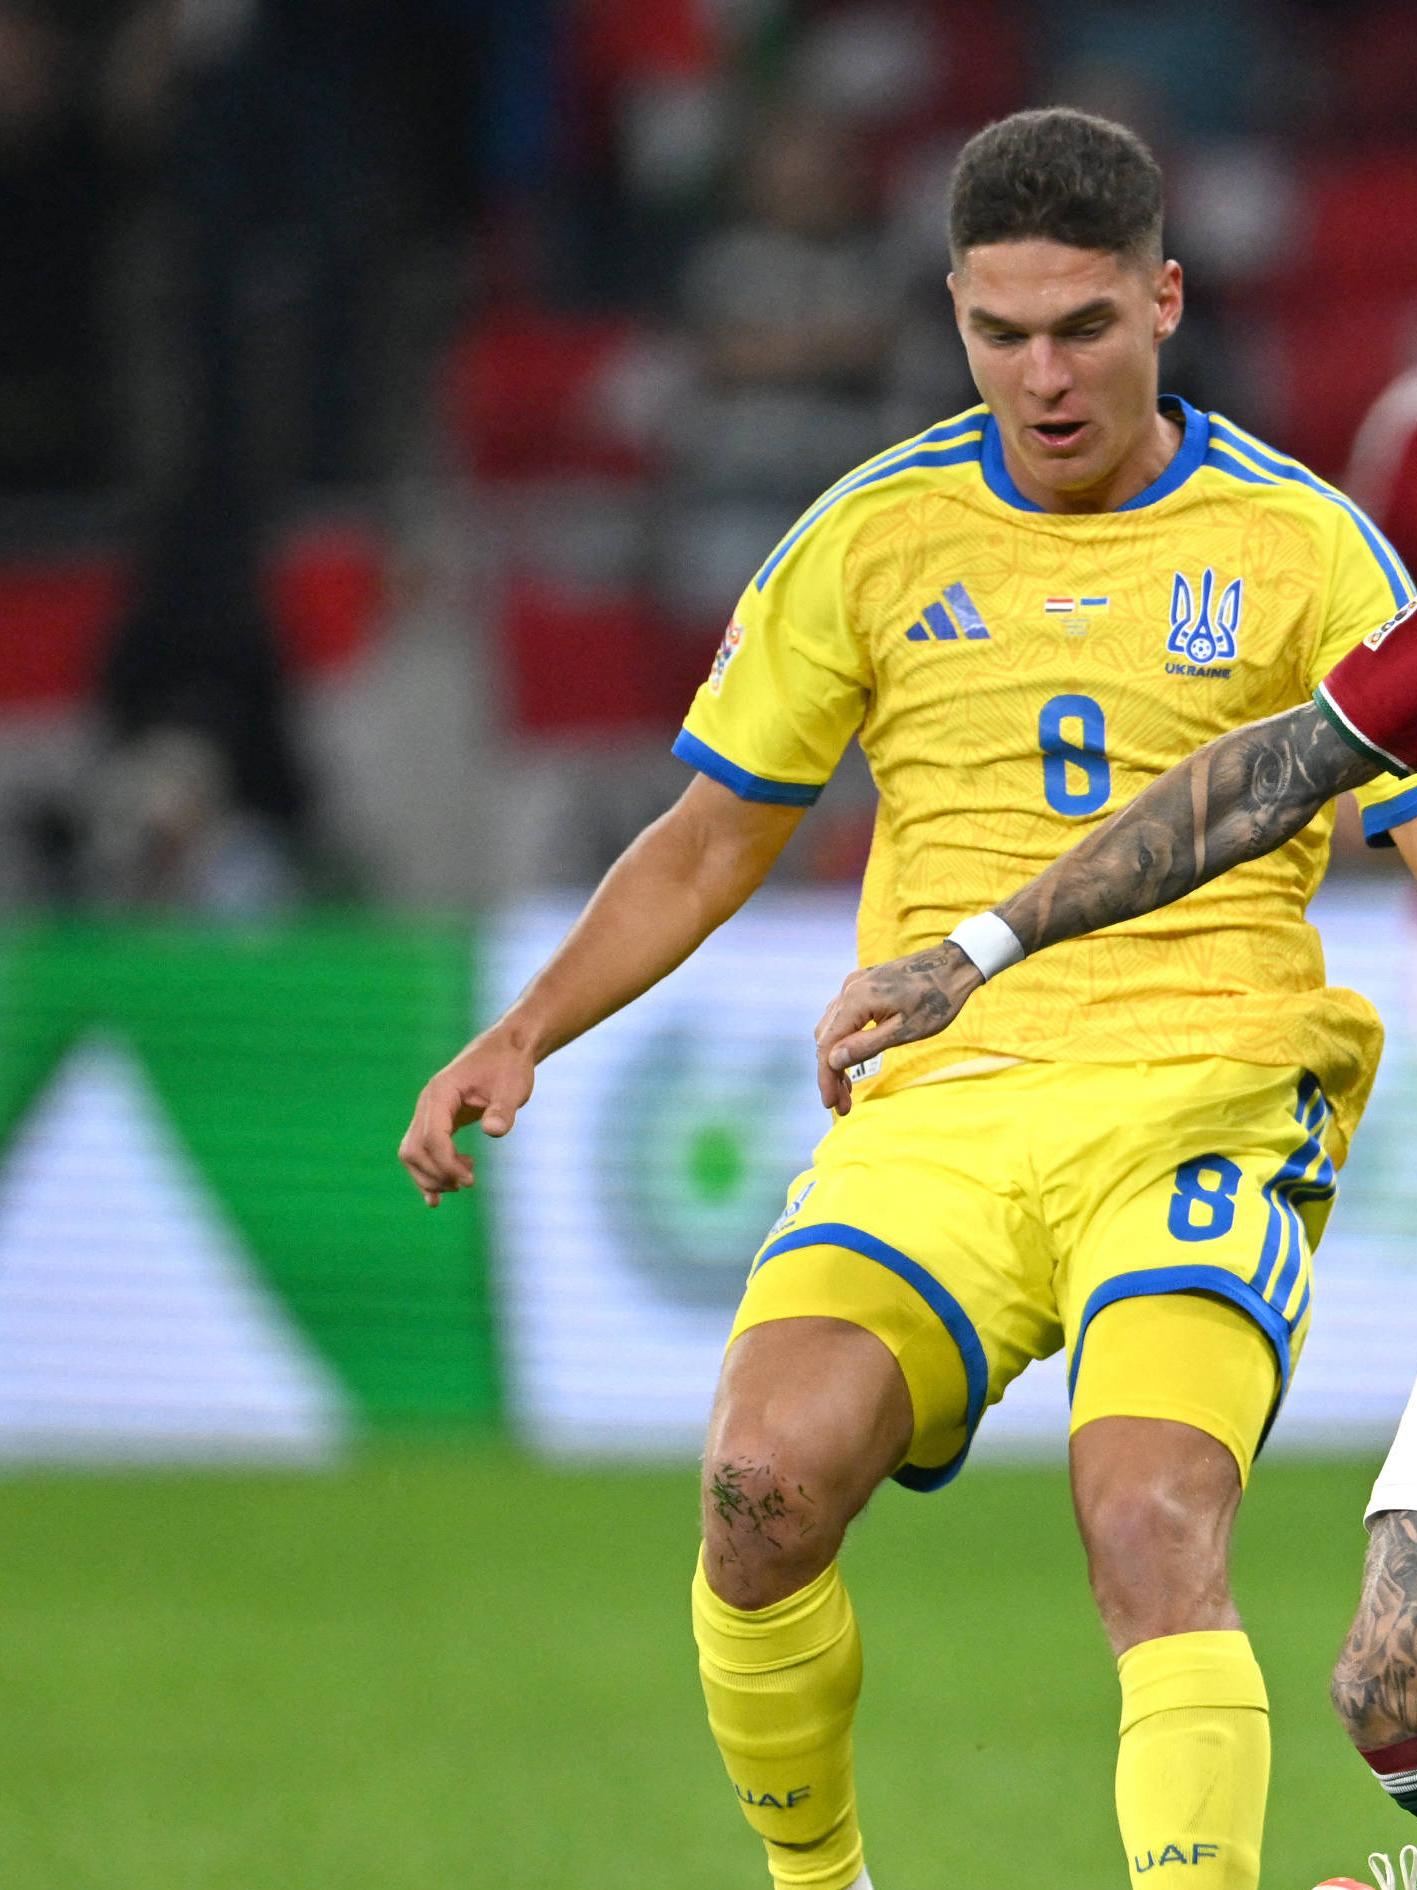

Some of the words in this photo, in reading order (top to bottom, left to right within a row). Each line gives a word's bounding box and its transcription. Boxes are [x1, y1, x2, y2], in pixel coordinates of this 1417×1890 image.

[1165, 663, 1232, 679] UKRAINE
[1040, 695, 1111, 816] 8
[1168, 1152, 1243, 1242] 8
[735, 1784, 811, 1809] UAF
[1135, 1843, 1218, 1873] UAF
